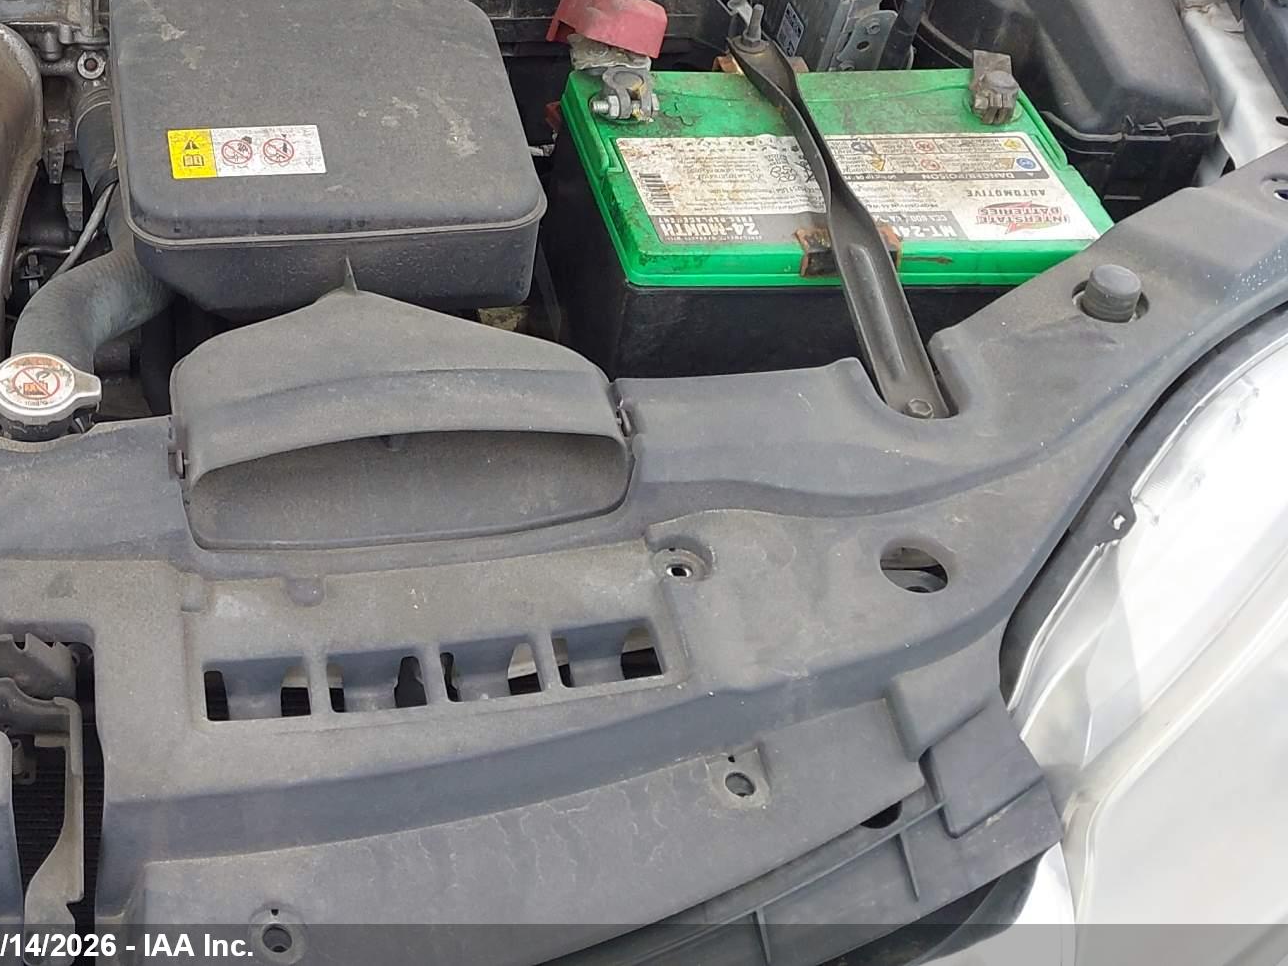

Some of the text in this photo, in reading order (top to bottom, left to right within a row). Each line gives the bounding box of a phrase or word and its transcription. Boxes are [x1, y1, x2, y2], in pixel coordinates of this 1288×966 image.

[965, 188, 1047, 198] AUTOMOTIVE
[977, 207, 1062, 217] BATTERIES
[975, 214, 1070, 225] INTERSTATE
[659, 222, 760, 236] 24-MONTH
